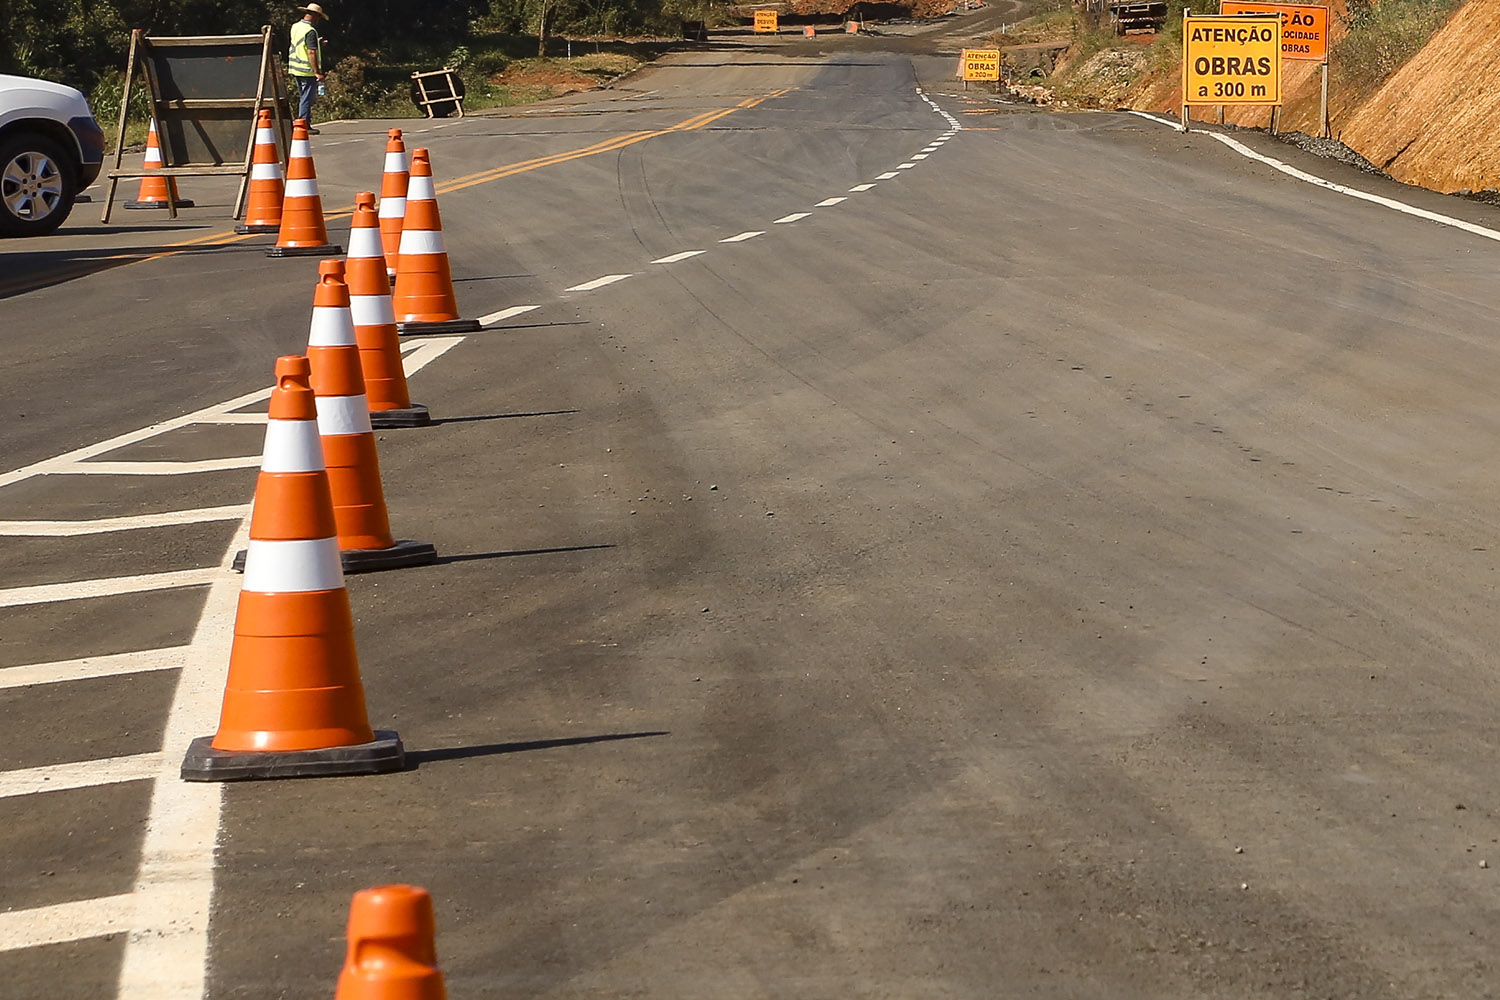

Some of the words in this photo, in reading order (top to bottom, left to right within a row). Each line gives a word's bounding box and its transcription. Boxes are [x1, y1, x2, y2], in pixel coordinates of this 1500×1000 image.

[1191, 26, 1273, 46] ATENÇÃO
[1281, 30, 1320, 41] OCIDADE
[1281, 43, 1310, 53] OBRAS
[968, 63, 996, 71] OBRAS
[1194, 57, 1271, 76] OBRAS
[1198, 85, 1208, 97] a
[1214, 82, 1245, 97] 300
[1251, 85, 1266, 96] m
